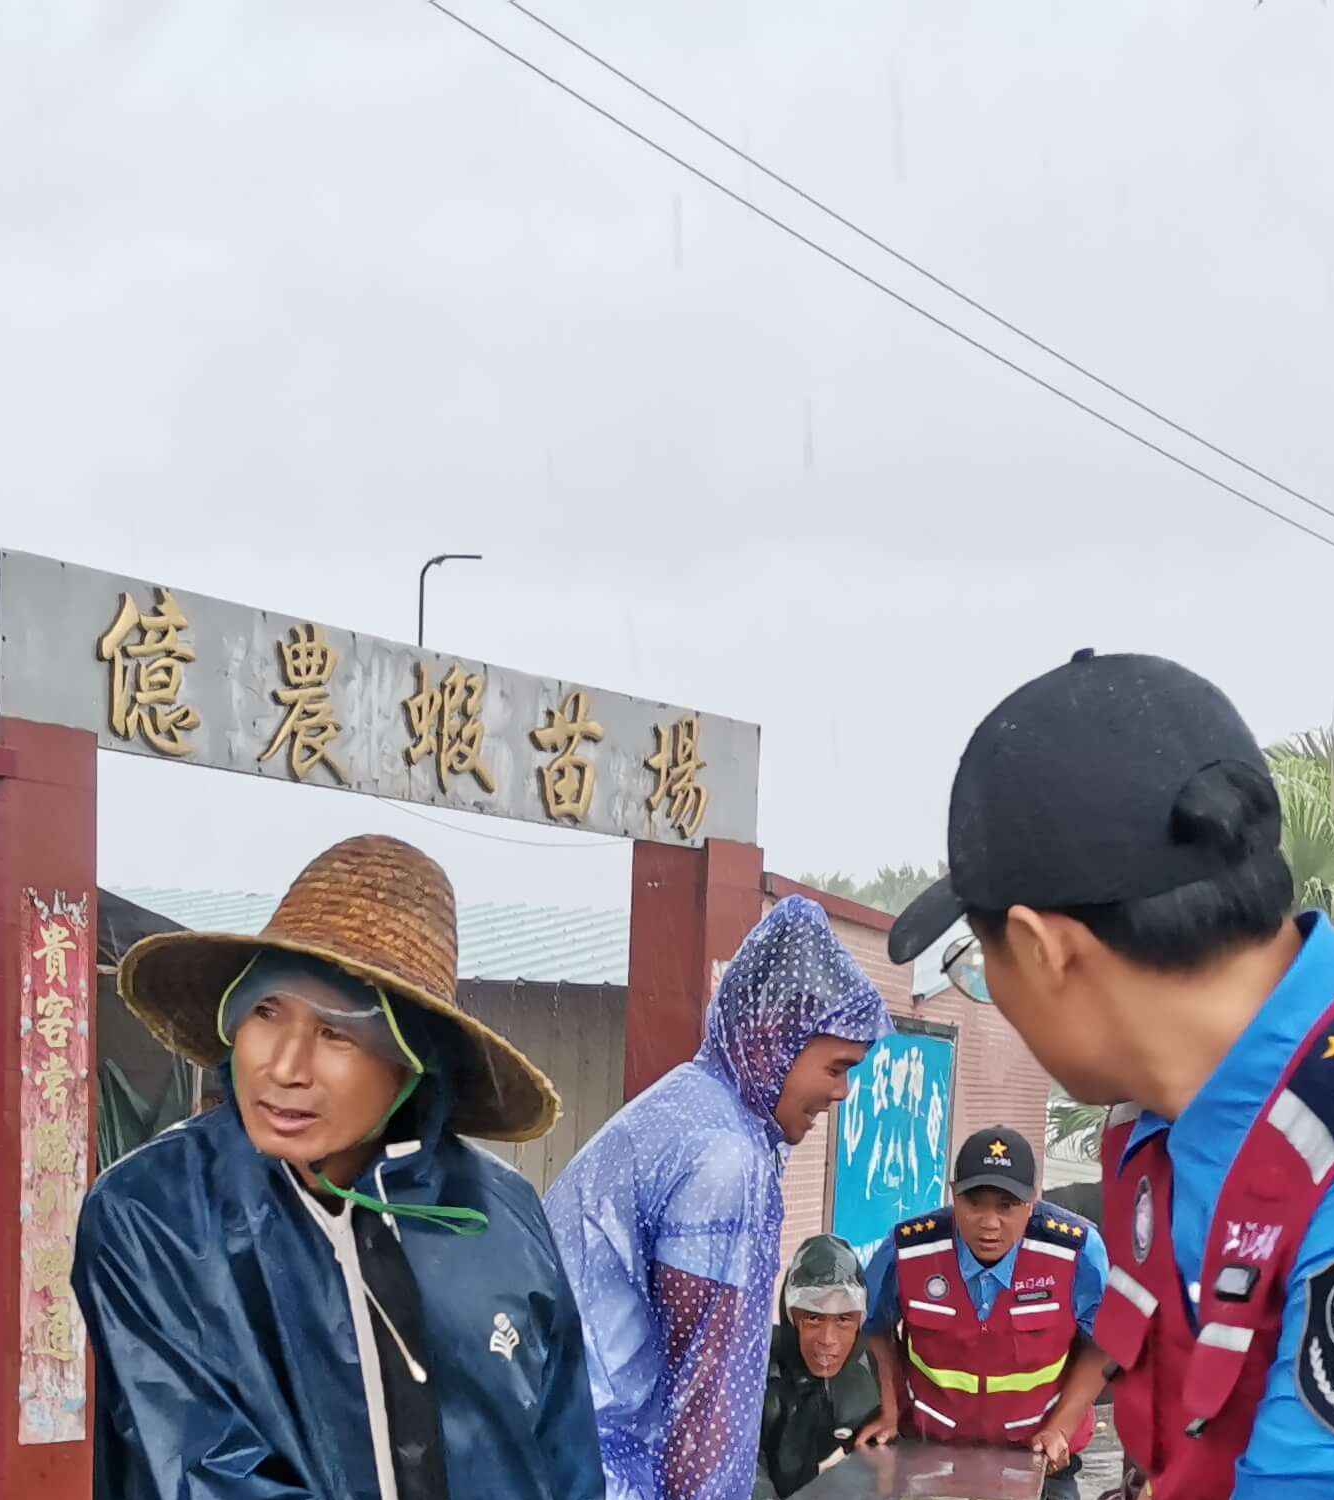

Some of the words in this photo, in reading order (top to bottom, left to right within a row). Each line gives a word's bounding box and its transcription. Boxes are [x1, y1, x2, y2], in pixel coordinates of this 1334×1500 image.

[96, 586, 708, 839] 億農蝦苗場
